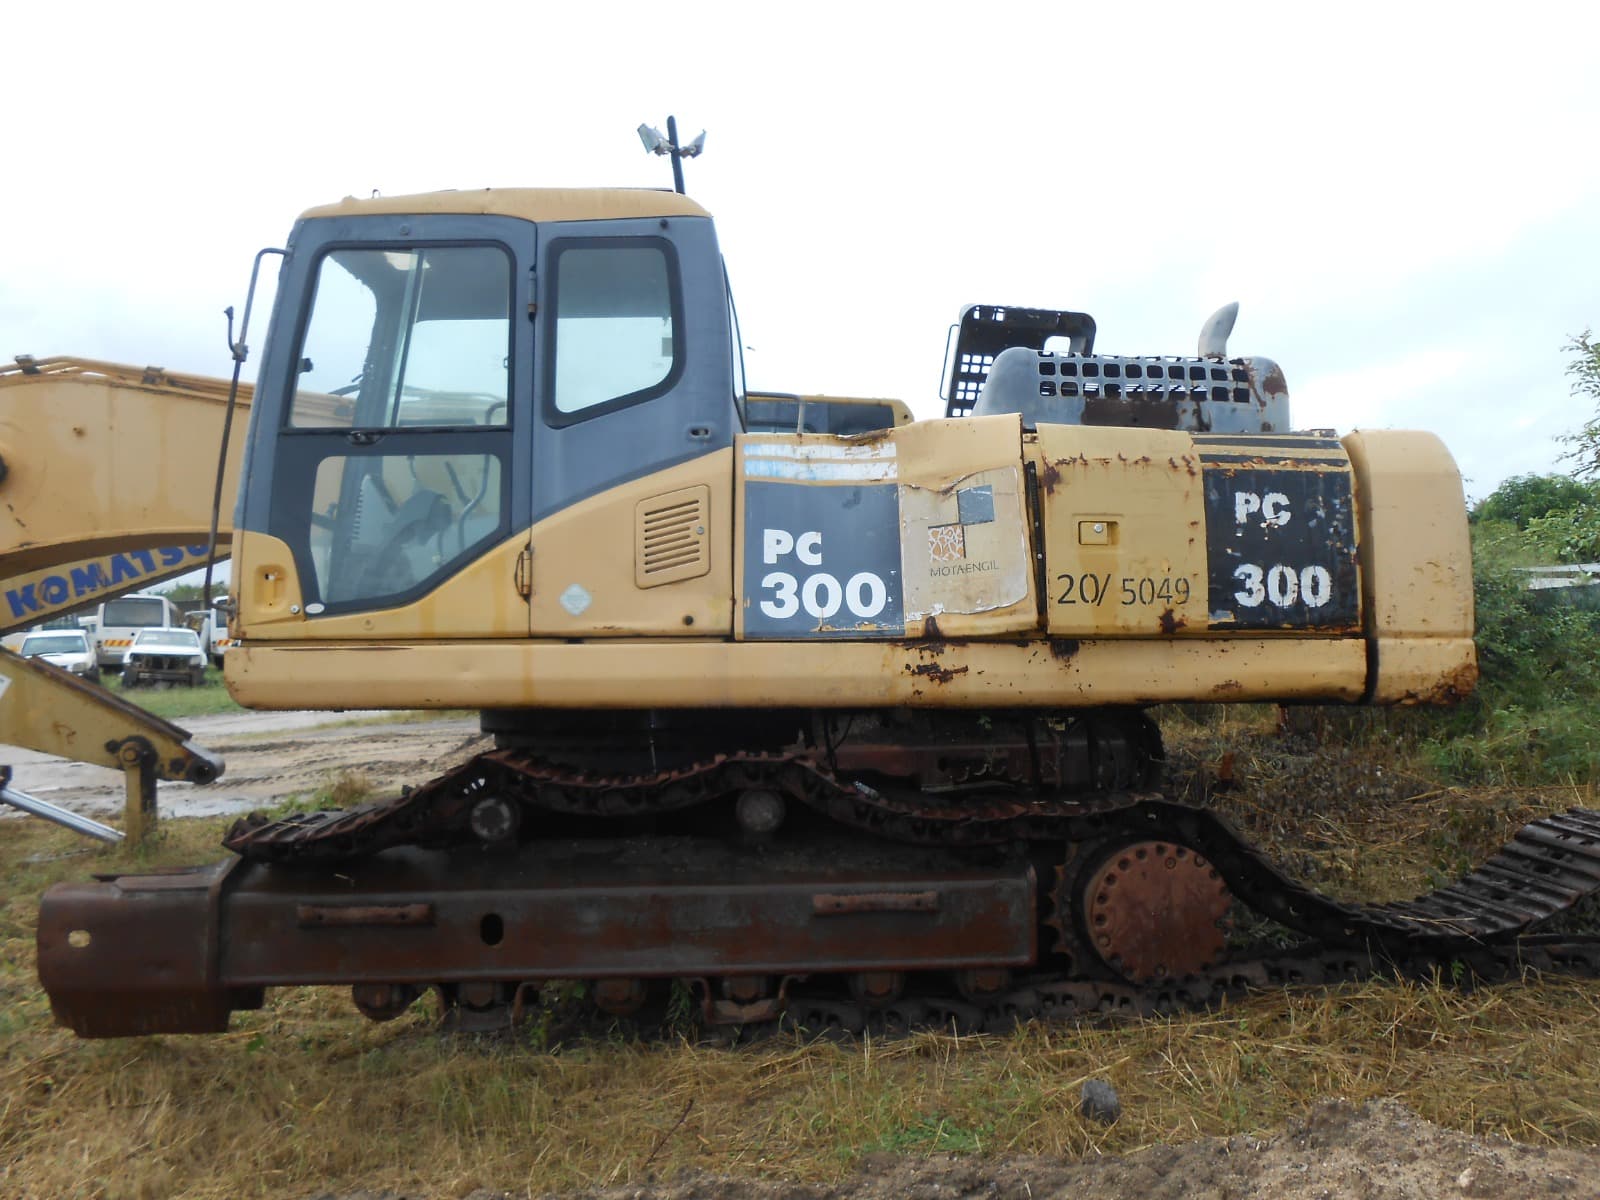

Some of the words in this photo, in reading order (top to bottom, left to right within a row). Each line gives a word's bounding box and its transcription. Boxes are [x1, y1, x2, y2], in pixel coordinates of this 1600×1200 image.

[1234, 491, 1292, 526] PC
[763, 528, 823, 566] PC
[930, 559, 1000, 577] MOTAENGIL
[1232, 563, 1333, 609] 300
[760, 572, 887, 619] 300
[1056, 573, 1112, 607] 20/
[1121, 576, 1191, 606] 5049
